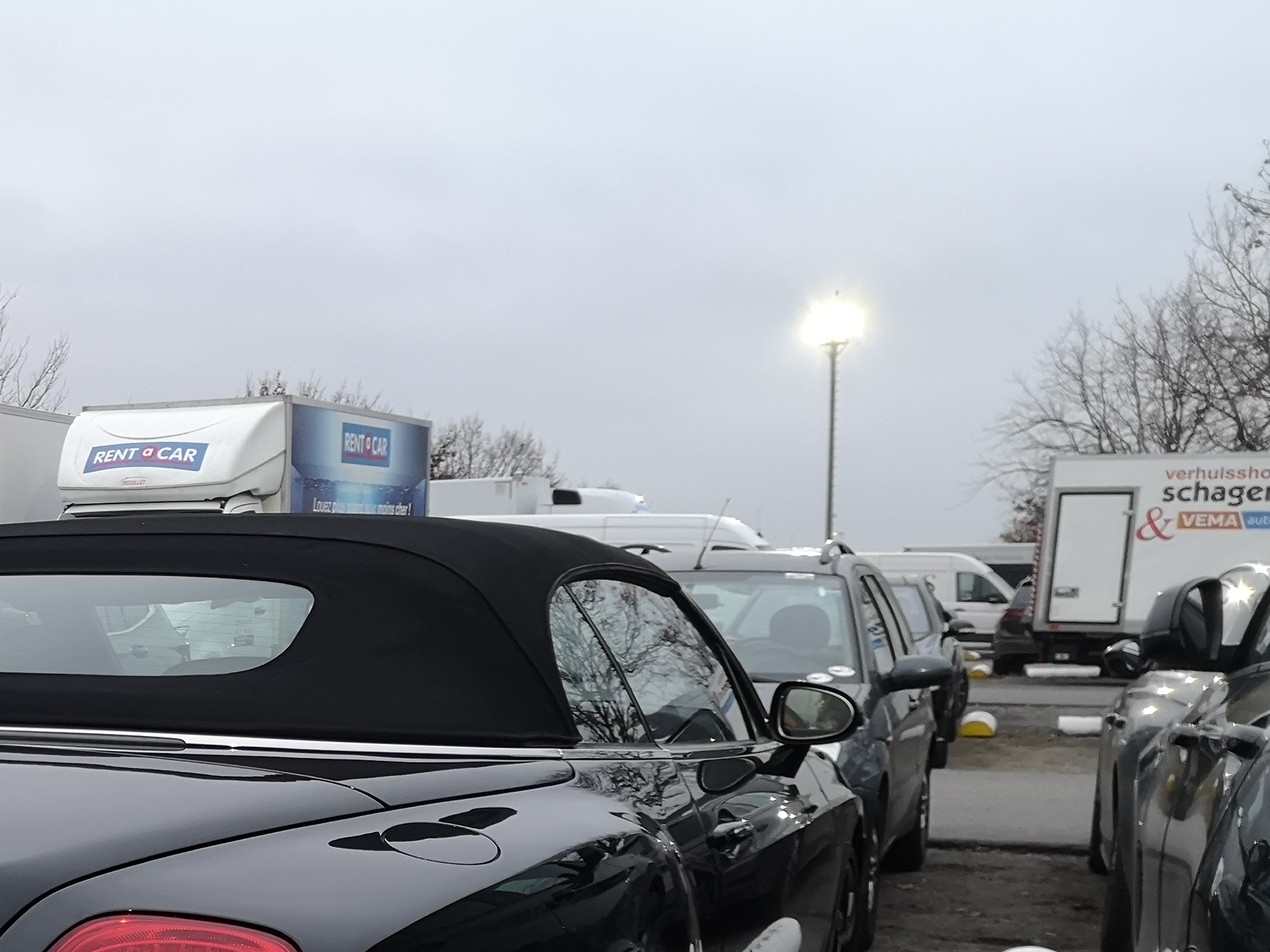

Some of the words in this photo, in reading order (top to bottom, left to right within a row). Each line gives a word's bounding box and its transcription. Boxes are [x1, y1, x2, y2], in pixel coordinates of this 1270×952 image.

[92, 447, 140, 465] RENT
[142, 447, 154, 457] a
[157, 446, 198, 463] CAR
[344, 432, 365, 454] RENT
[372, 436, 389, 457] CAR
[1135, 506, 1174, 541] &
[1181, 514, 1238, 527] VEMA
[1247, 515, 1270, 526] aut
